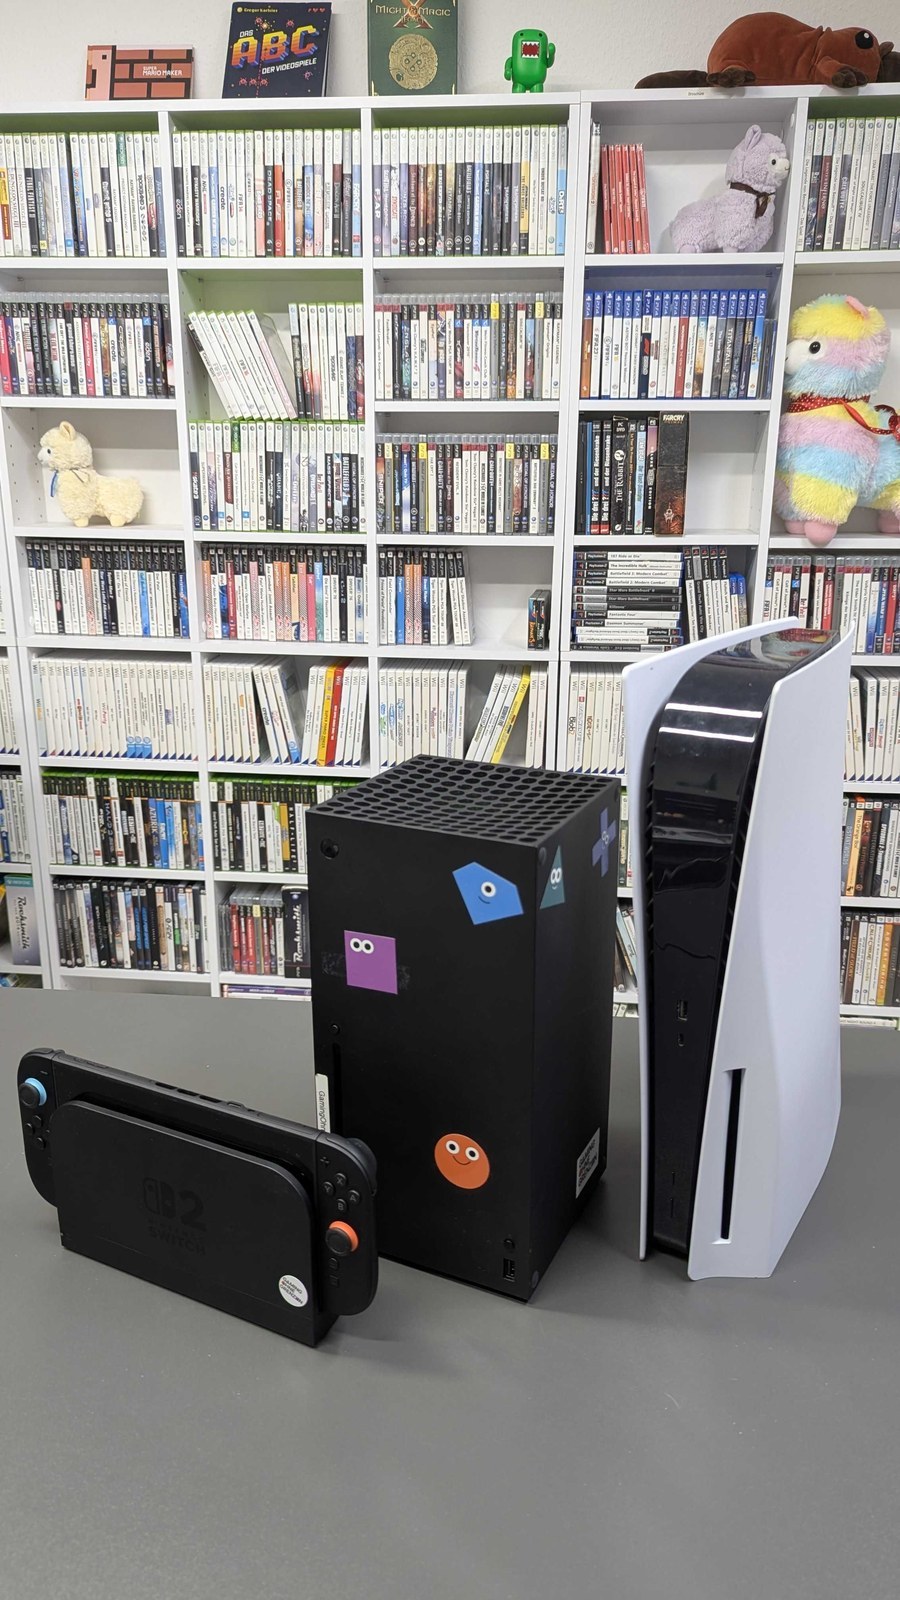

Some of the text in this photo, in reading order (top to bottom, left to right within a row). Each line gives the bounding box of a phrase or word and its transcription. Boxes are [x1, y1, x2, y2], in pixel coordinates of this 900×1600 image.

[376, 5, 406, 13] MIGHT
[418, 7, 450, 16] MAGIC
[231, 25, 319, 68] ABC
[276, 58, 317, 72] VIDEOSPIELE
[724, 328, 733, 366] TITANFALL
[616, 462, 624, 487] RABBIT
[149, 807, 157, 834] AZURIK
[853, 824, 861, 840] Orange
[17, 897, 30, 949] Rocksmith
[293, 904, 303, 962] Rocksmith
[883, 932, 891, 962] ADVENT
